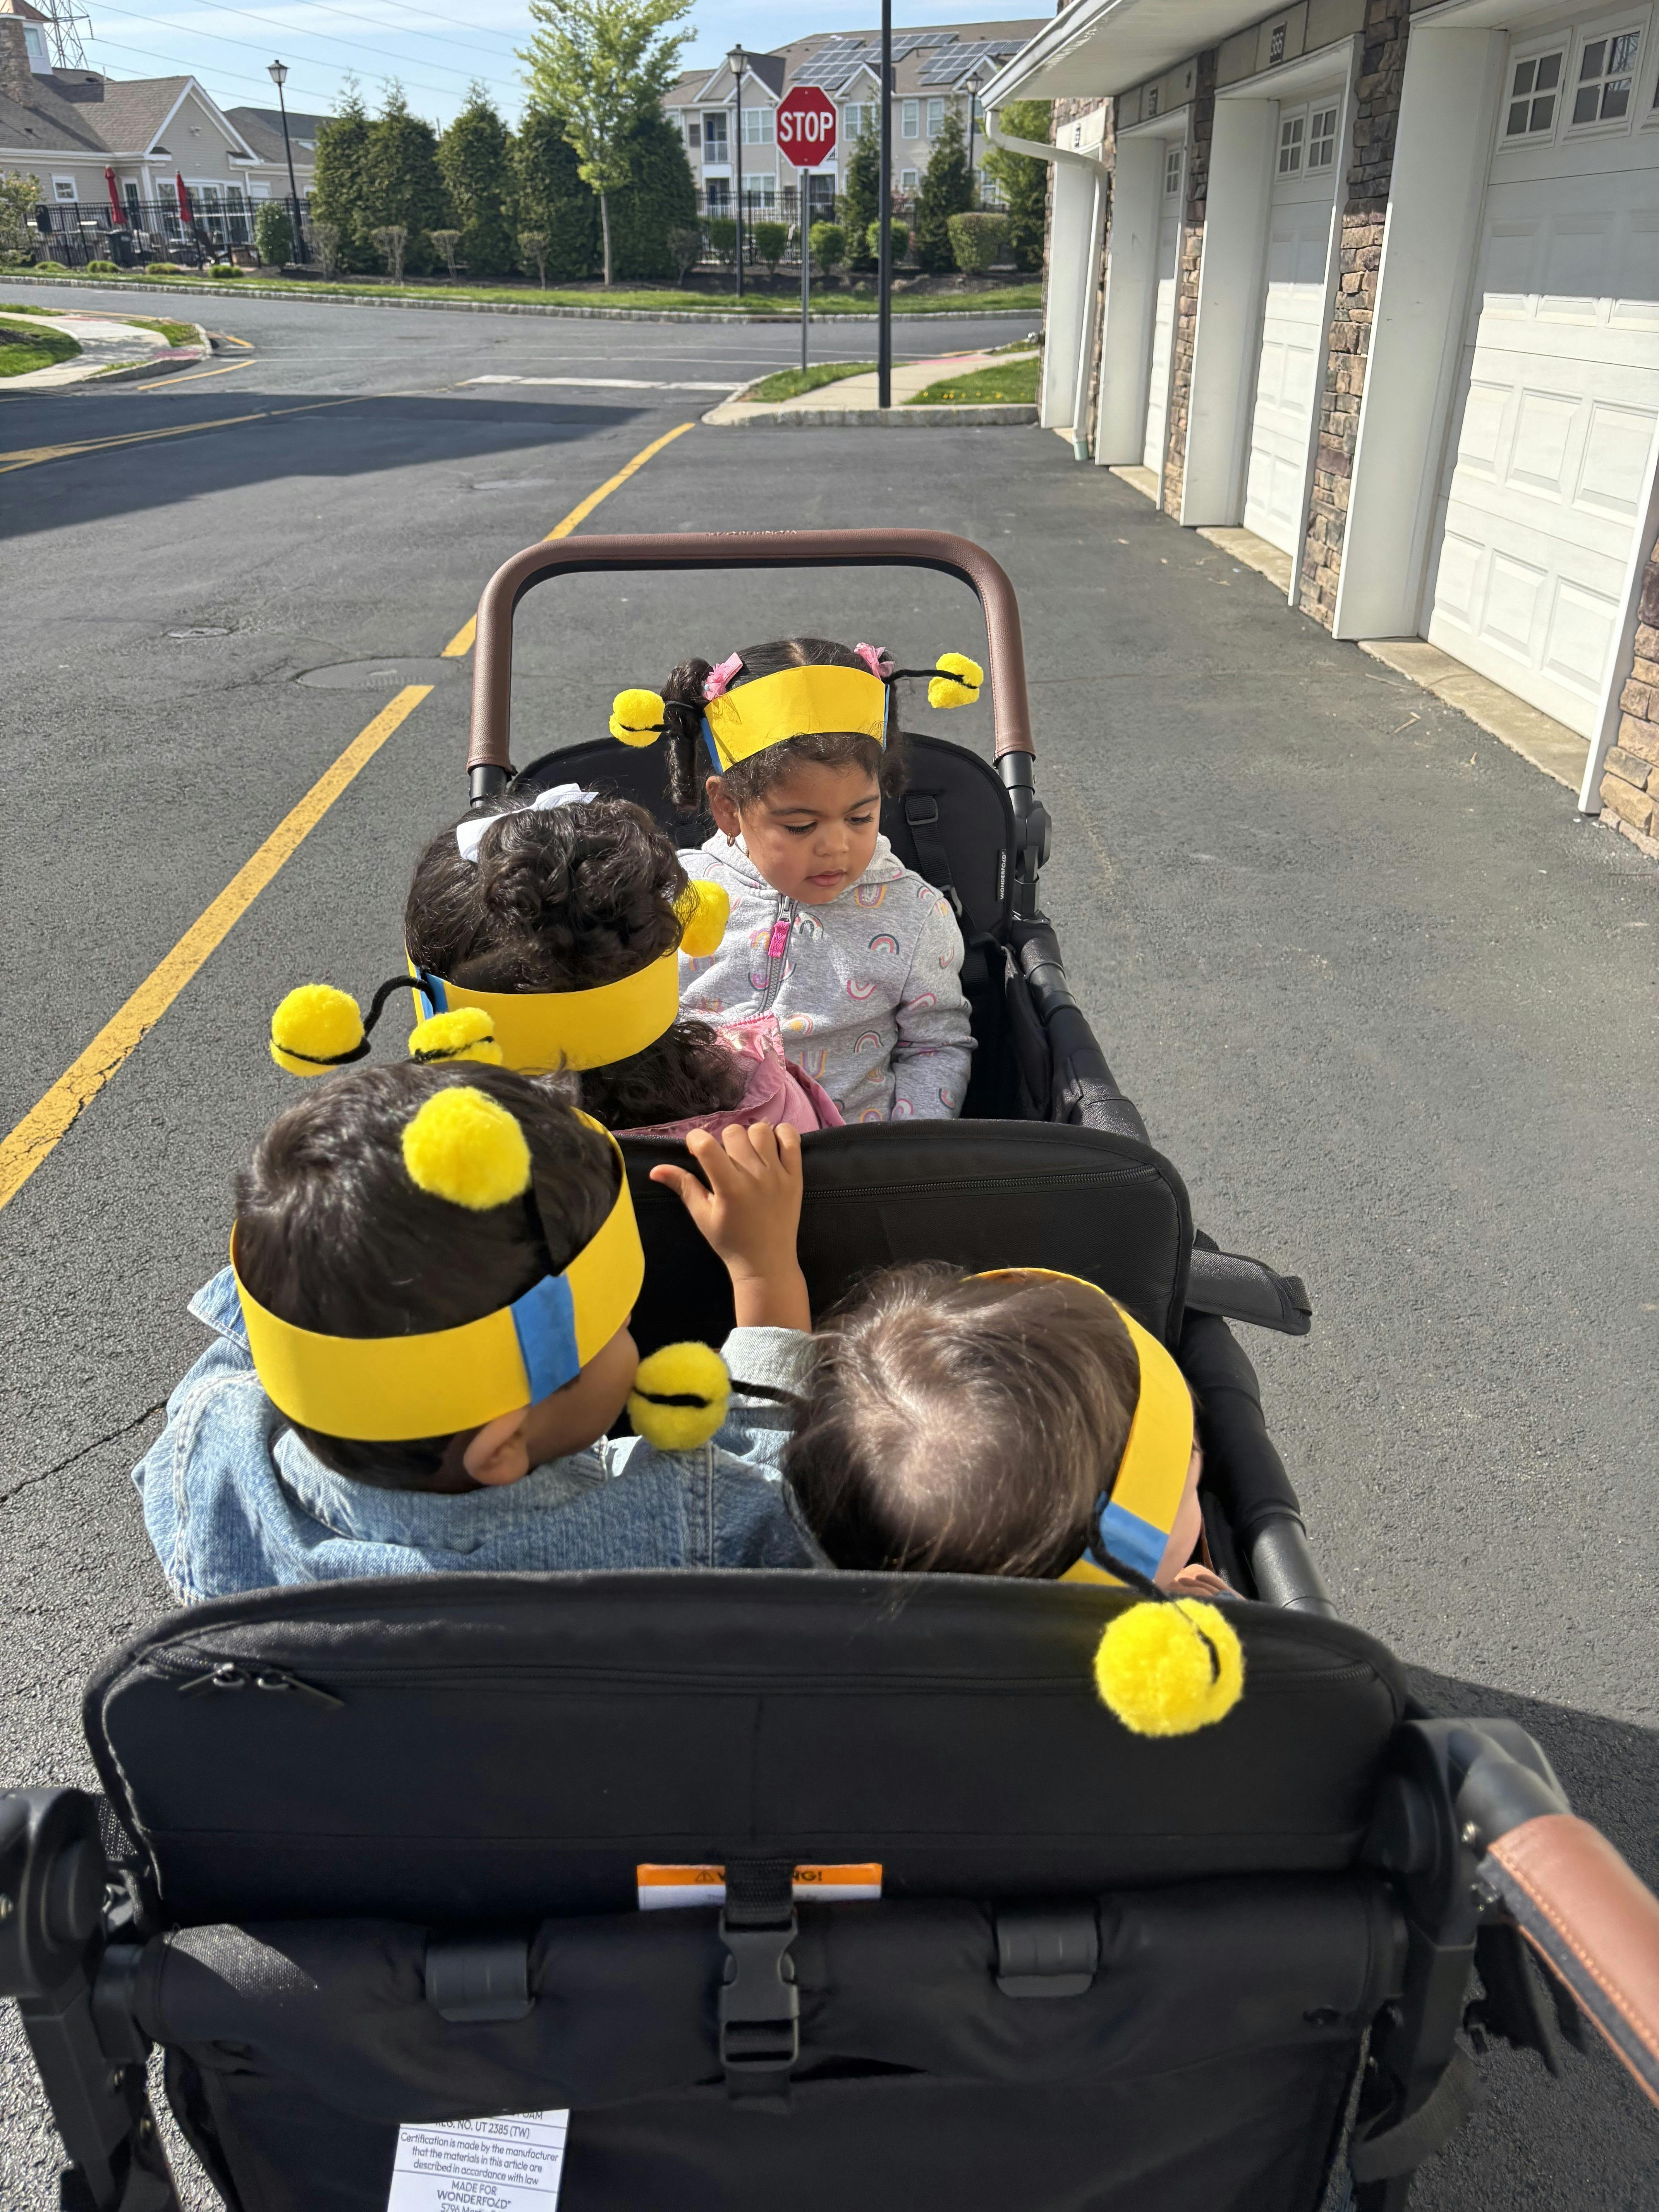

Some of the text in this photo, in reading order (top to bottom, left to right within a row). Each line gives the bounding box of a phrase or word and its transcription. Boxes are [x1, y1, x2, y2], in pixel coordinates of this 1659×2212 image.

[779, 112, 833, 143] STOP
[476, 2121, 488, 2132] UT
[488, 2123, 508, 2135] 2385
[510, 2126, 530, 2139] (TW)
[401, 2132, 558, 2161] Certification is made by the manufacturer
[412, 2146, 543, 2172] that the materials in this article are
[414, 2159, 539, 2185] described in accordance with law
[452, 2180, 497, 2196] MADE FOR
